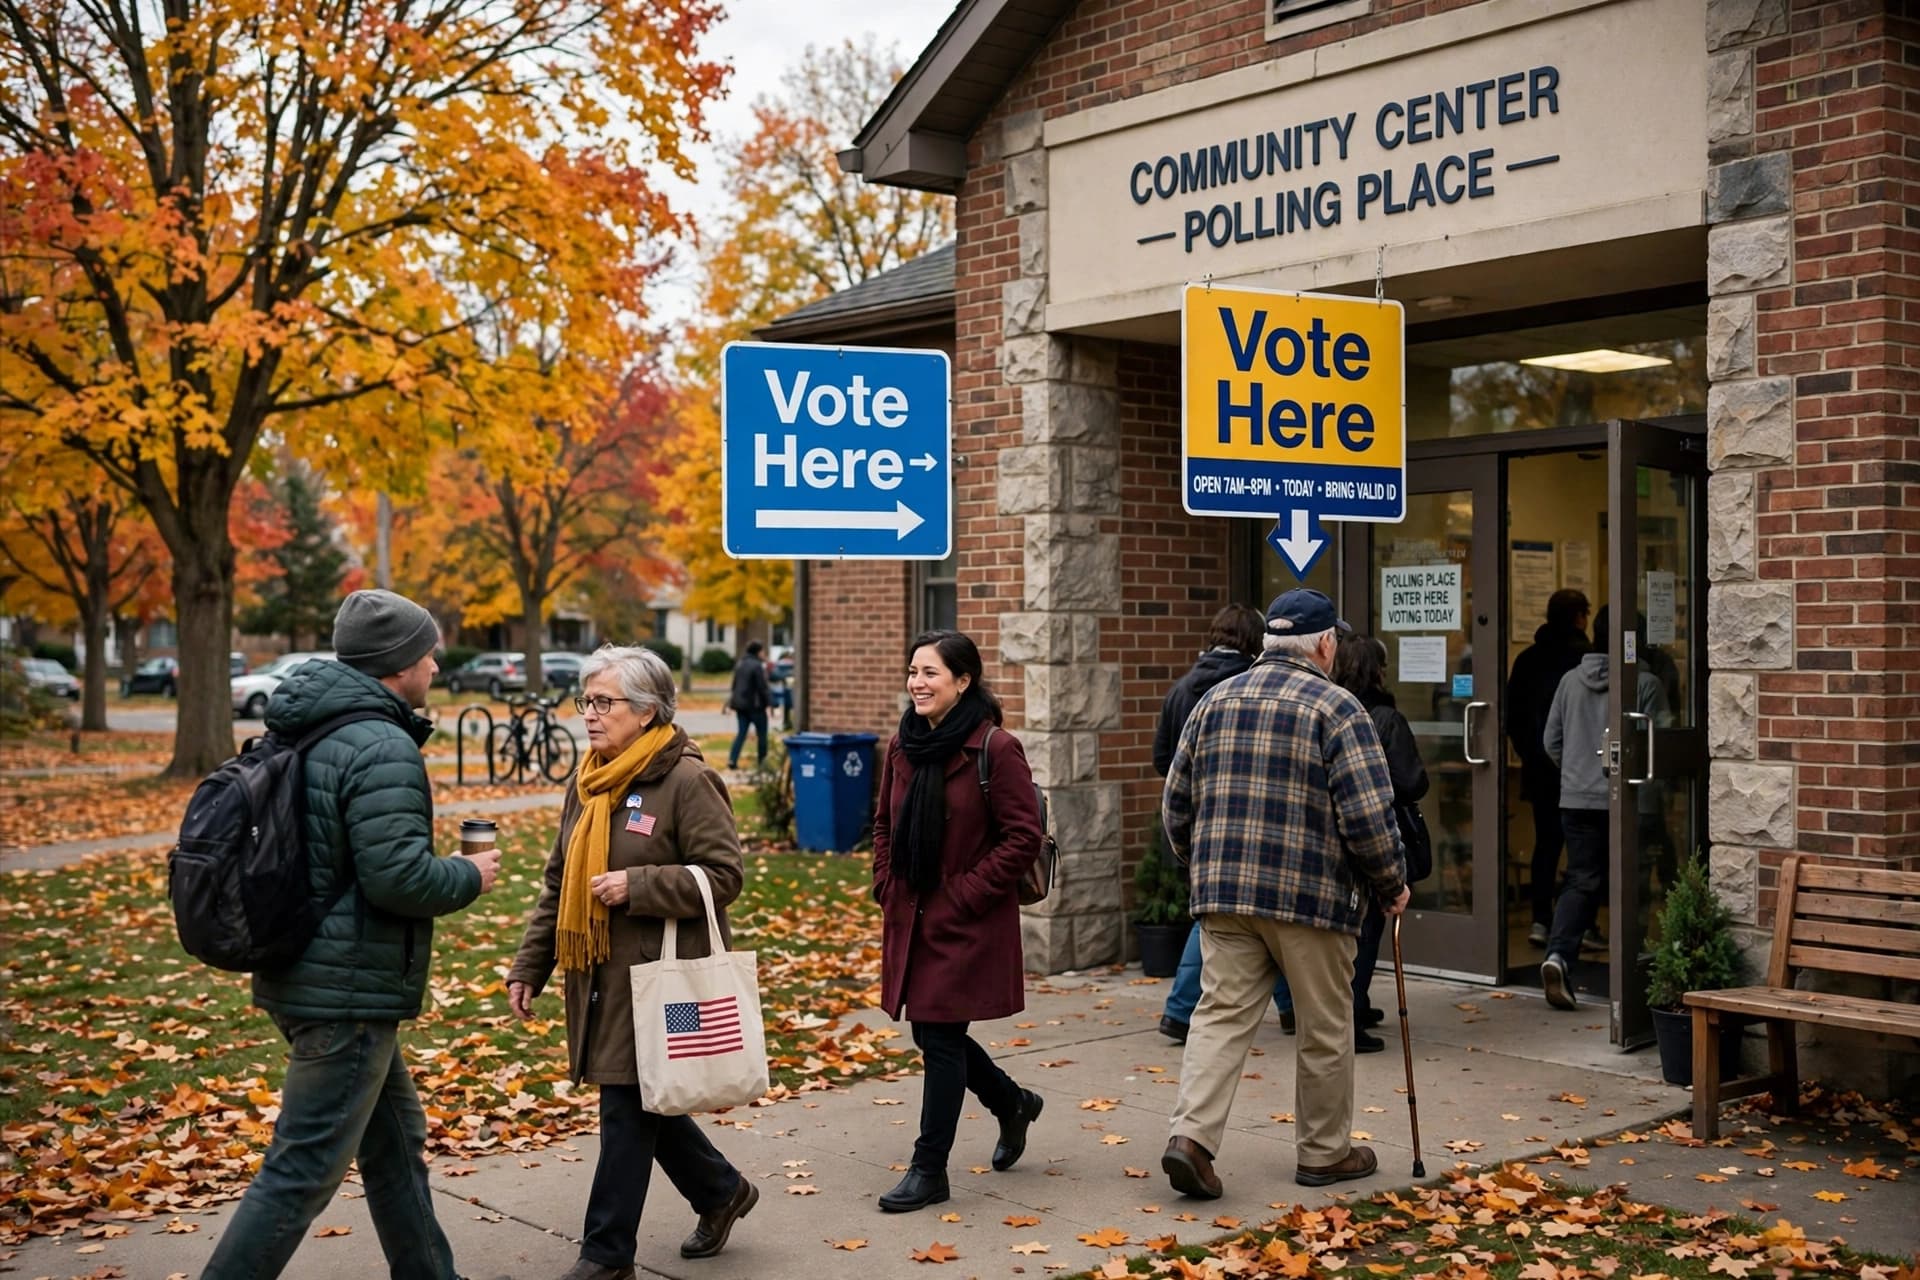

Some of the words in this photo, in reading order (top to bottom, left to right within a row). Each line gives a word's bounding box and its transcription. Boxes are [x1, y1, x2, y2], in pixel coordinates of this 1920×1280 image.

[1130, 112, 1357, 205] COMMUNITY
[1375, 65, 1560, 150] CENTER
[1184, 180, 1341, 253] POLLING
[1357, 147, 1495, 220] PLACE
[1218, 306, 1371, 381] Vote
[763, 368, 909, 429] Vote
[1217, 379, 1375, 453] Here
[754, 433, 905, 491] Here
[1193, 475, 1222, 494] OPEN
[1282, 479, 1315, 498] TODAY
[1325, 481, 1355, 500] BRING
[1355, 482, 1385, 501] VALID
[1386, 483, 1397, 501] ID
[1385, 573, 1423, 589] POLLING
[1426, 572, 1456, 587] PLACE
[1392, 591, 1422, 606] ENTER
[1424, 590, 1449, 605] HERE
[1388, 609, 1422, 624] VOTING
[1424, 608, 1454, 623] TODAY
